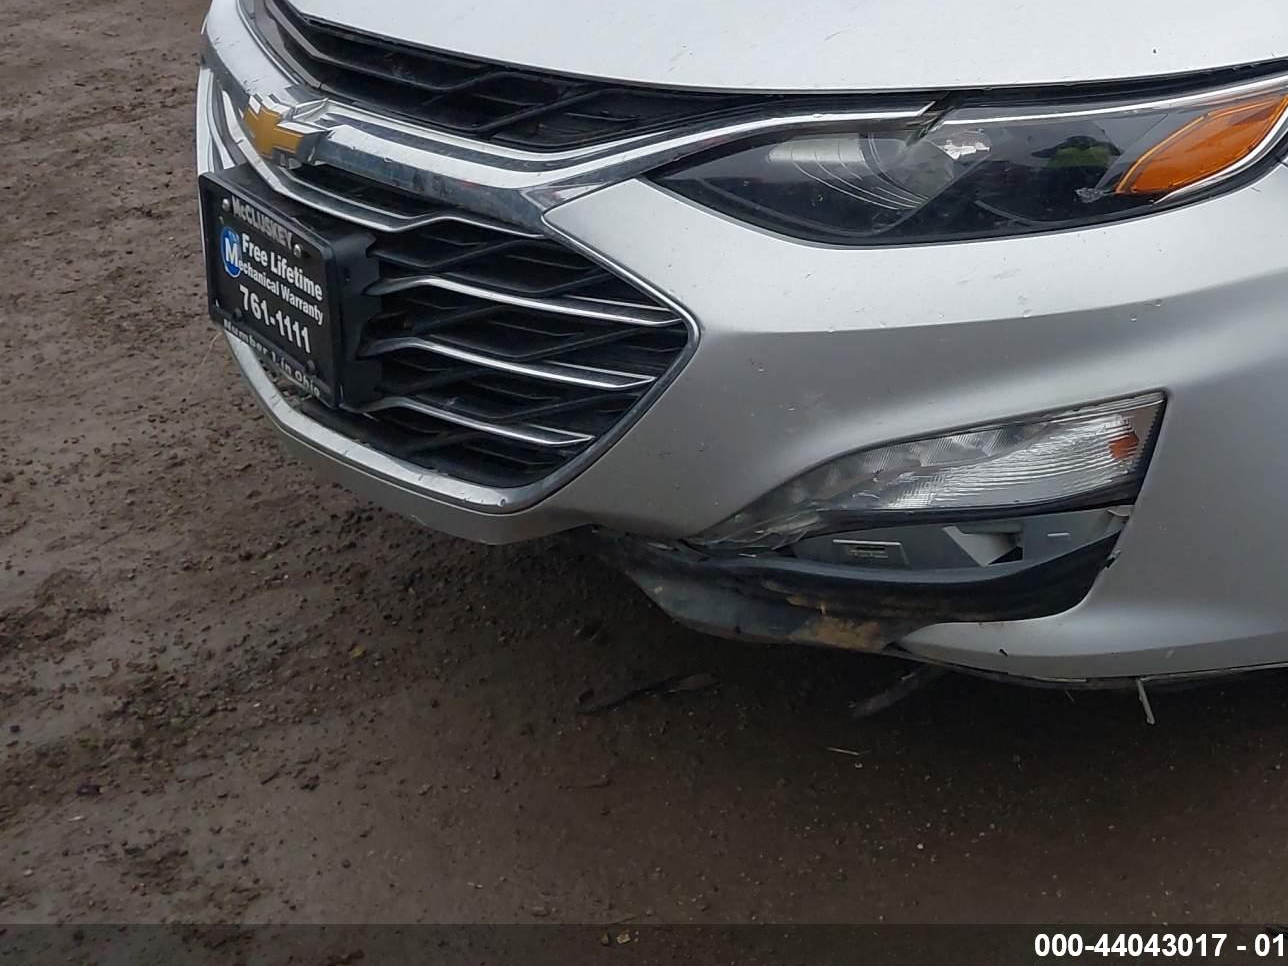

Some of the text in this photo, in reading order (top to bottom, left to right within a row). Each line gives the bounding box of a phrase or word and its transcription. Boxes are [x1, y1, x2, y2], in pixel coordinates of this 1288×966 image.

[231, 195, 293, 250] McCLUSKEY
[224, 237, 324, 326] Mechanical Warranty
[241, 233, 324, 302] Free Lifetime
[239, 284, 311, 354] 761-1111
[223, 319, 268, 355] Number
[280, 357, 292, 375] in
[294, 370, 321, 397] Ohio
